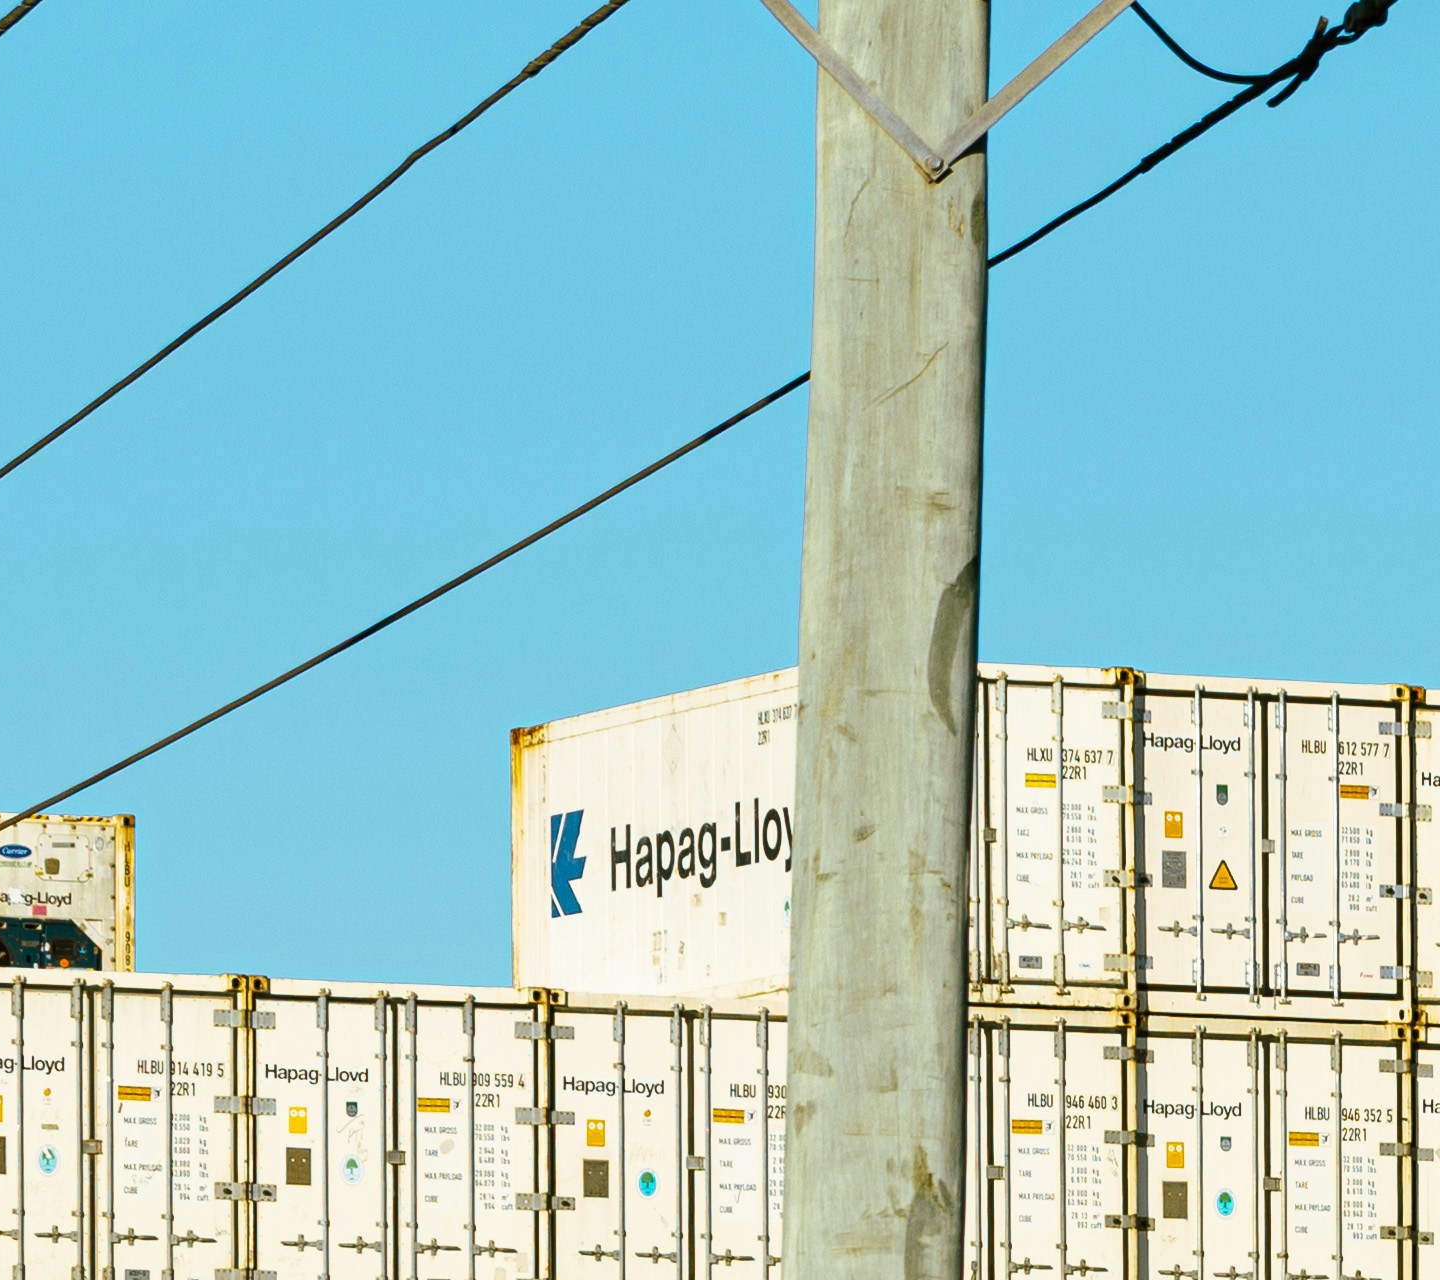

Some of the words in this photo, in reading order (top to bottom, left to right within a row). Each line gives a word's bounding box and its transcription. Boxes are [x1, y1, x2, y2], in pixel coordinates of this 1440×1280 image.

[1301, 740, 1327, 755] HLBU
[1338, 741, 1357, 756] 612
[1360, 742, 1378, 757] 577
[1382, 743, 1390, 758] 7
[1338, 761, 1365, 776] 22R1
[0, 845, 29, 858] Carrier
[611, 798, 794, 898] Hapag-Lloy
[439, 1071, 467, 1087] HLBU
[472, 1073, 492, 1089] 909
[494, 1073, 514, 1089] 559
[517, 1074, 525, 1090] 4
[475, 1093, 501, 1109] 22R1
[1304, 1106, 1330, 1121] HLBU
[1342, 1108, 1360, 1122] 946
[1364, 1108, 1381, 1123] 352
[1386, 1109, 1393, 1124] 5
[1342, 1127, 1367, 1142] 22R1
